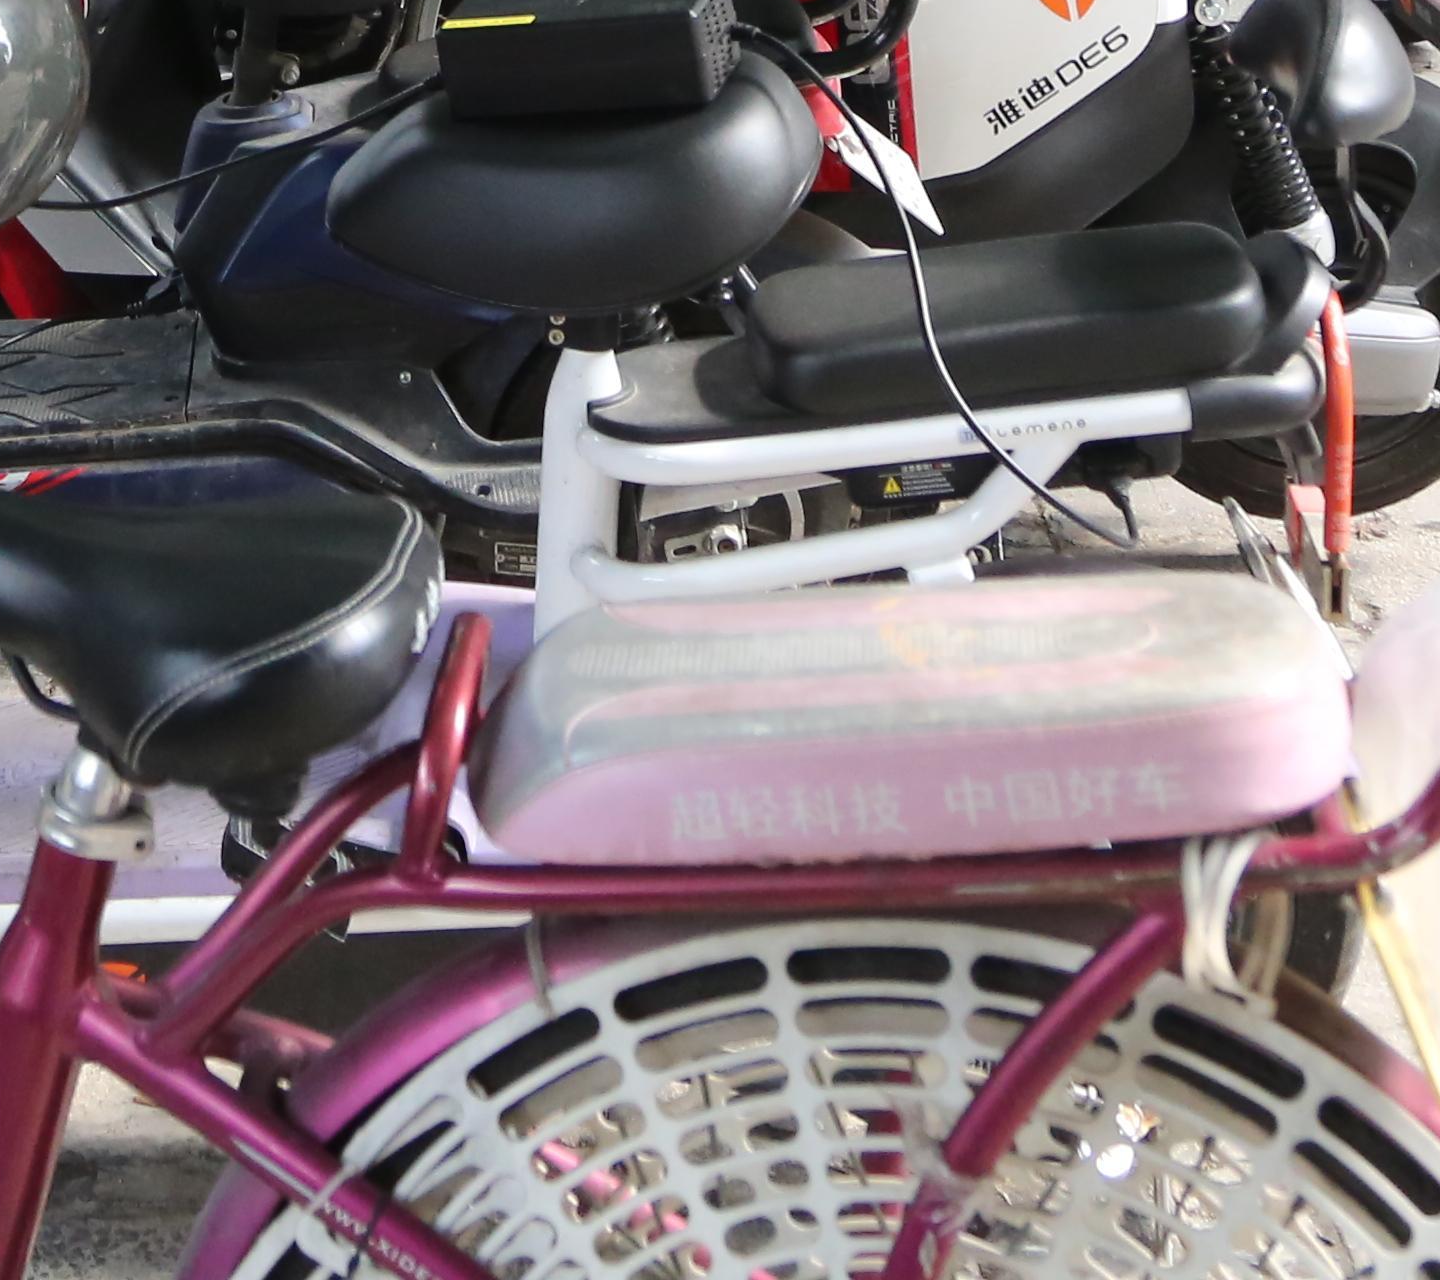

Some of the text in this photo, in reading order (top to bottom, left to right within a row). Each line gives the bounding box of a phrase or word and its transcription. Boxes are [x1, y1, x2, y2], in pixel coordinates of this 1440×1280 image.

[672, 761, 1185, 841] 超轻科技 中国好车
